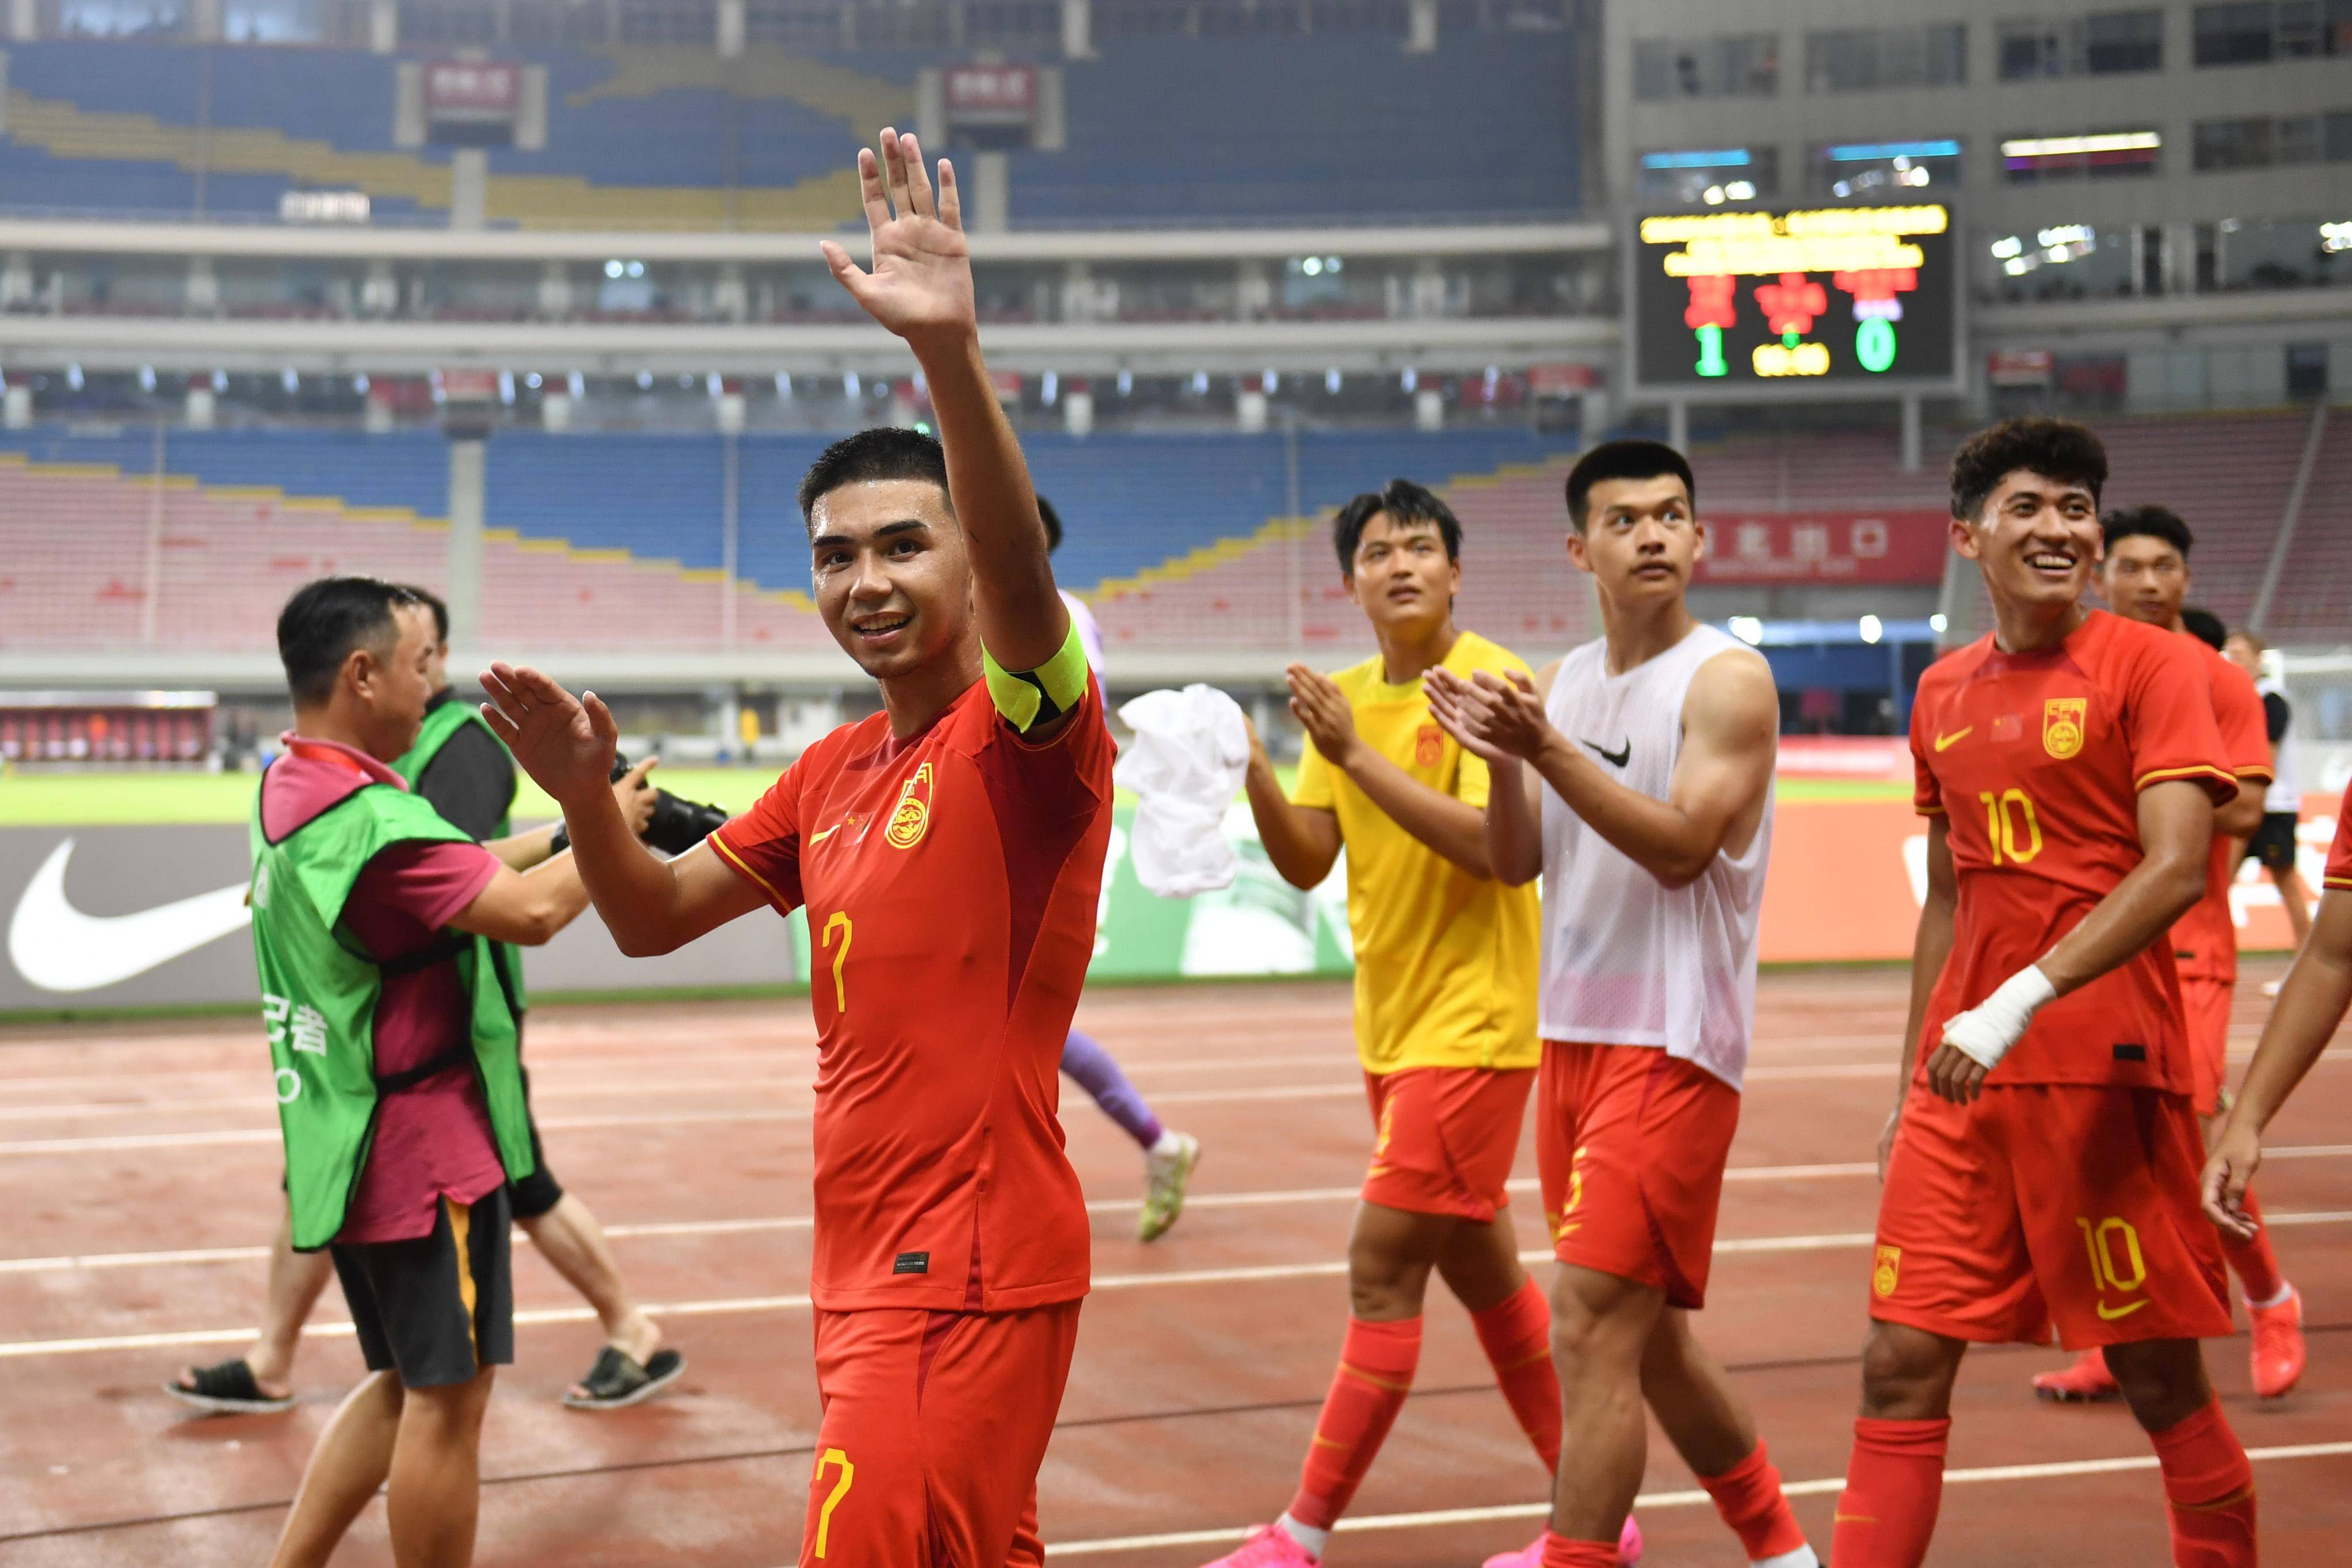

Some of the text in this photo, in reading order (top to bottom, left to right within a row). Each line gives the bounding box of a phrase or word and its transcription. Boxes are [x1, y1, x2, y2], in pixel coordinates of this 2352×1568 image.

[1695, 323, 1727, 376] 1
[1855, 315, 1896, 372] 0
[1980, 788, 2042, 865] 10
[822, 910, 852, 1012] 7
[2077, 1216, 2145, 1292] 10
[815, 1448, 855, 1559] 7
